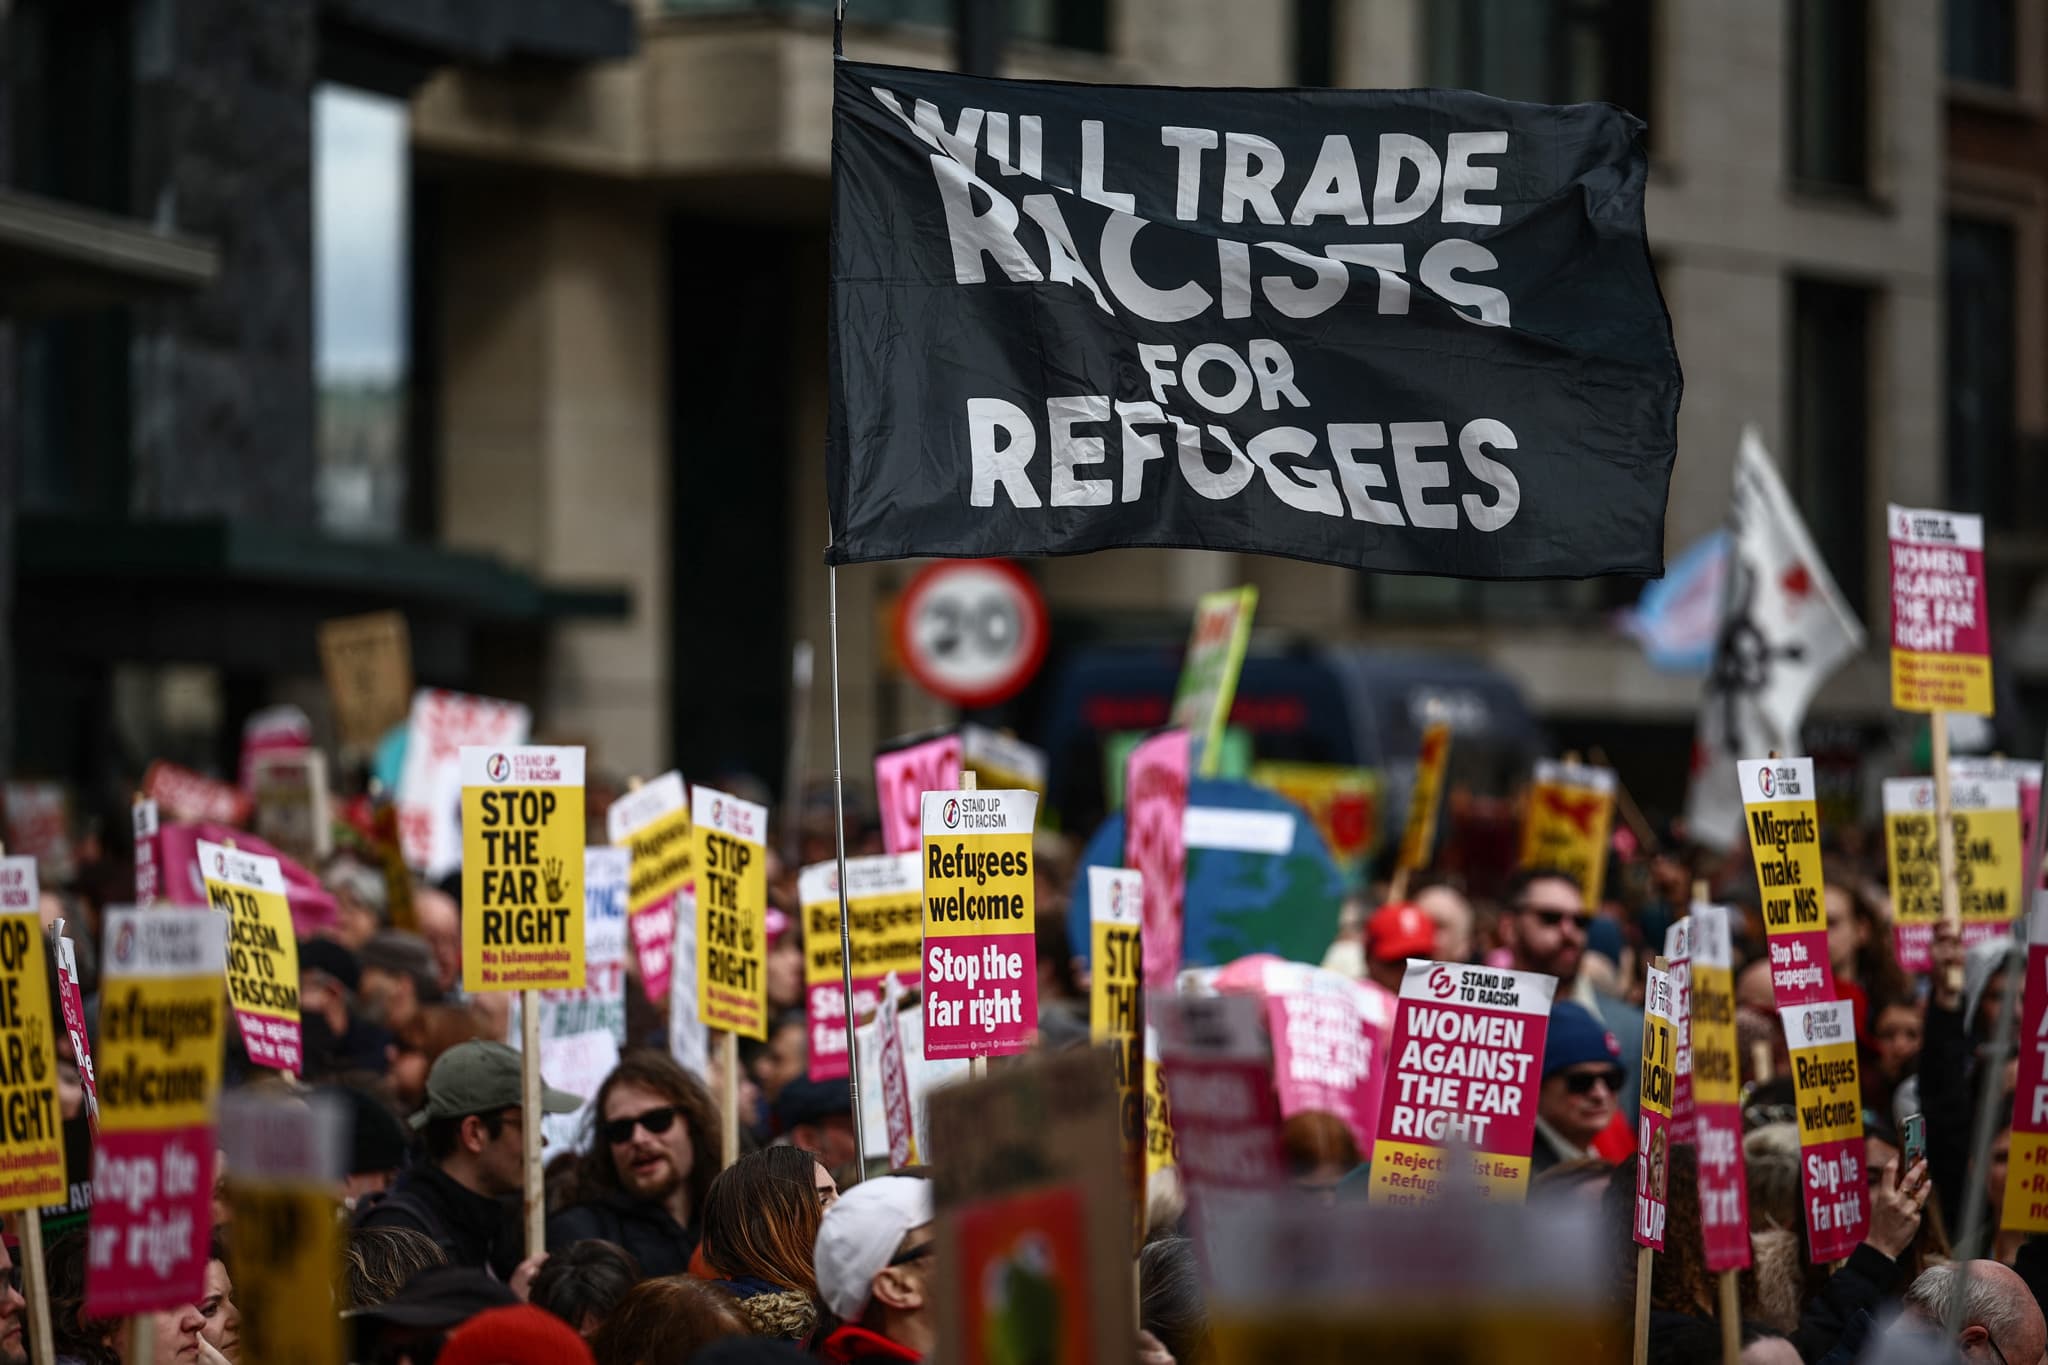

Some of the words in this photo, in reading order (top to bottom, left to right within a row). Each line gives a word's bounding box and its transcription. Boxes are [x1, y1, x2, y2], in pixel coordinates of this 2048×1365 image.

[871, 86, 1135, 215] WILL
[1161, 126, 1509, 225] TRADE
[929, 154, 1511, 327] RACISTS
[1137, 339, 1311, 414] FOR
[967, 395, 1520, 532] REFUGEES
[1892, 544, 1966, 574] WOMEN
[1894, 571, 1976, 600] AGAINST
[1895, 593, 1929, 621] THE
[1934, 599, 1975, 629] FAR
[921, 605, 1019, 659] 20
[1895, 622, 1955, 651] RIGHT
[529, 769, 560, 781] RACISM
[545, 755, 556, 767] UP
[481, 790, 556, 826] STOP
[962, 799, 985, 812] STAND
[988, 798, 1000, 812] UP
[963, 815, 974, 828] TO
[976, 814, 1006, 828] RACISM
[482, 831, 539, 865] THE
[1752, 810, 1815, 852] Migrants
[706, 834, 751, 877] STOP
[929, 843, 1027, 886] Refugees
[1762, 853, 1801, 887] make
[210, 885, 234, 915] NO
[235, 891, 260, 919] TO
[482, 870, 538, 905] FAR
[706, 871, 737, 911] THE
[929, 887, 1024, 922] welcome
[1766, 899, 1791, 925] our
[1794, 888, 1818, 924] NHS
[0, 920, 29, 971] OP
[226, 919, 285, 955] ACISM,
[482, 909, 570, 945] RIGHT
[707, 908, 738, 949] FAR
[225, 947, 249, 974] NO
[251, 950, 274, 979] TO
[482, 950, 498, 964] No
[707, 947, 758, 992] RIGHT
[929, 946, 980, 990] Stop
[983, 944, 1022, 980] the
[1771, 942, 1791, 967] Stop
[1792, 940, 1808, 961] the
[230, 976, 299, 1011] FASCISM
[482, 969, 498, 983] No
[1462, 971, 1499, 988] STAND
[1501, 976, 1515, 990] UP
[928, 991, 963, 1027] far
[969, 988, 1022, 1033] right
[1460, 987, 1475, 1002] TO
[1478, 989, 1519, 1007] RACISM
[1407, 1005, 1524, 1049] WOMEN
[1645, 1018, 1654, 1061] NO
[1398, 1040, 1533, 1083] AGAINST
[1796, 1053, 1856, 1093] Refugees
[1398, 1072, 1461, 1108] THE
[1466, 1081, 1522, 1116] FAR
[0, 1091, 55, 1143] IGHT
[1390, 1105, 1491, 1145] RIGHT
[1802, 1096, 1856, 1131] welcome
[1640, 1114, 1650, 1156] NO
[95, 1148, 157, 1214] top
[1392, 1151, 1442, 1172] Reject
[1493, 1159, 1519, 1179] lies
[1807, 1154, 1839, 1194] Stop
[1840, 1149, 1858, 1181] the
[1812, 1196, 1832, 1231] far
[1833, 1193, 1863, 1233] right
